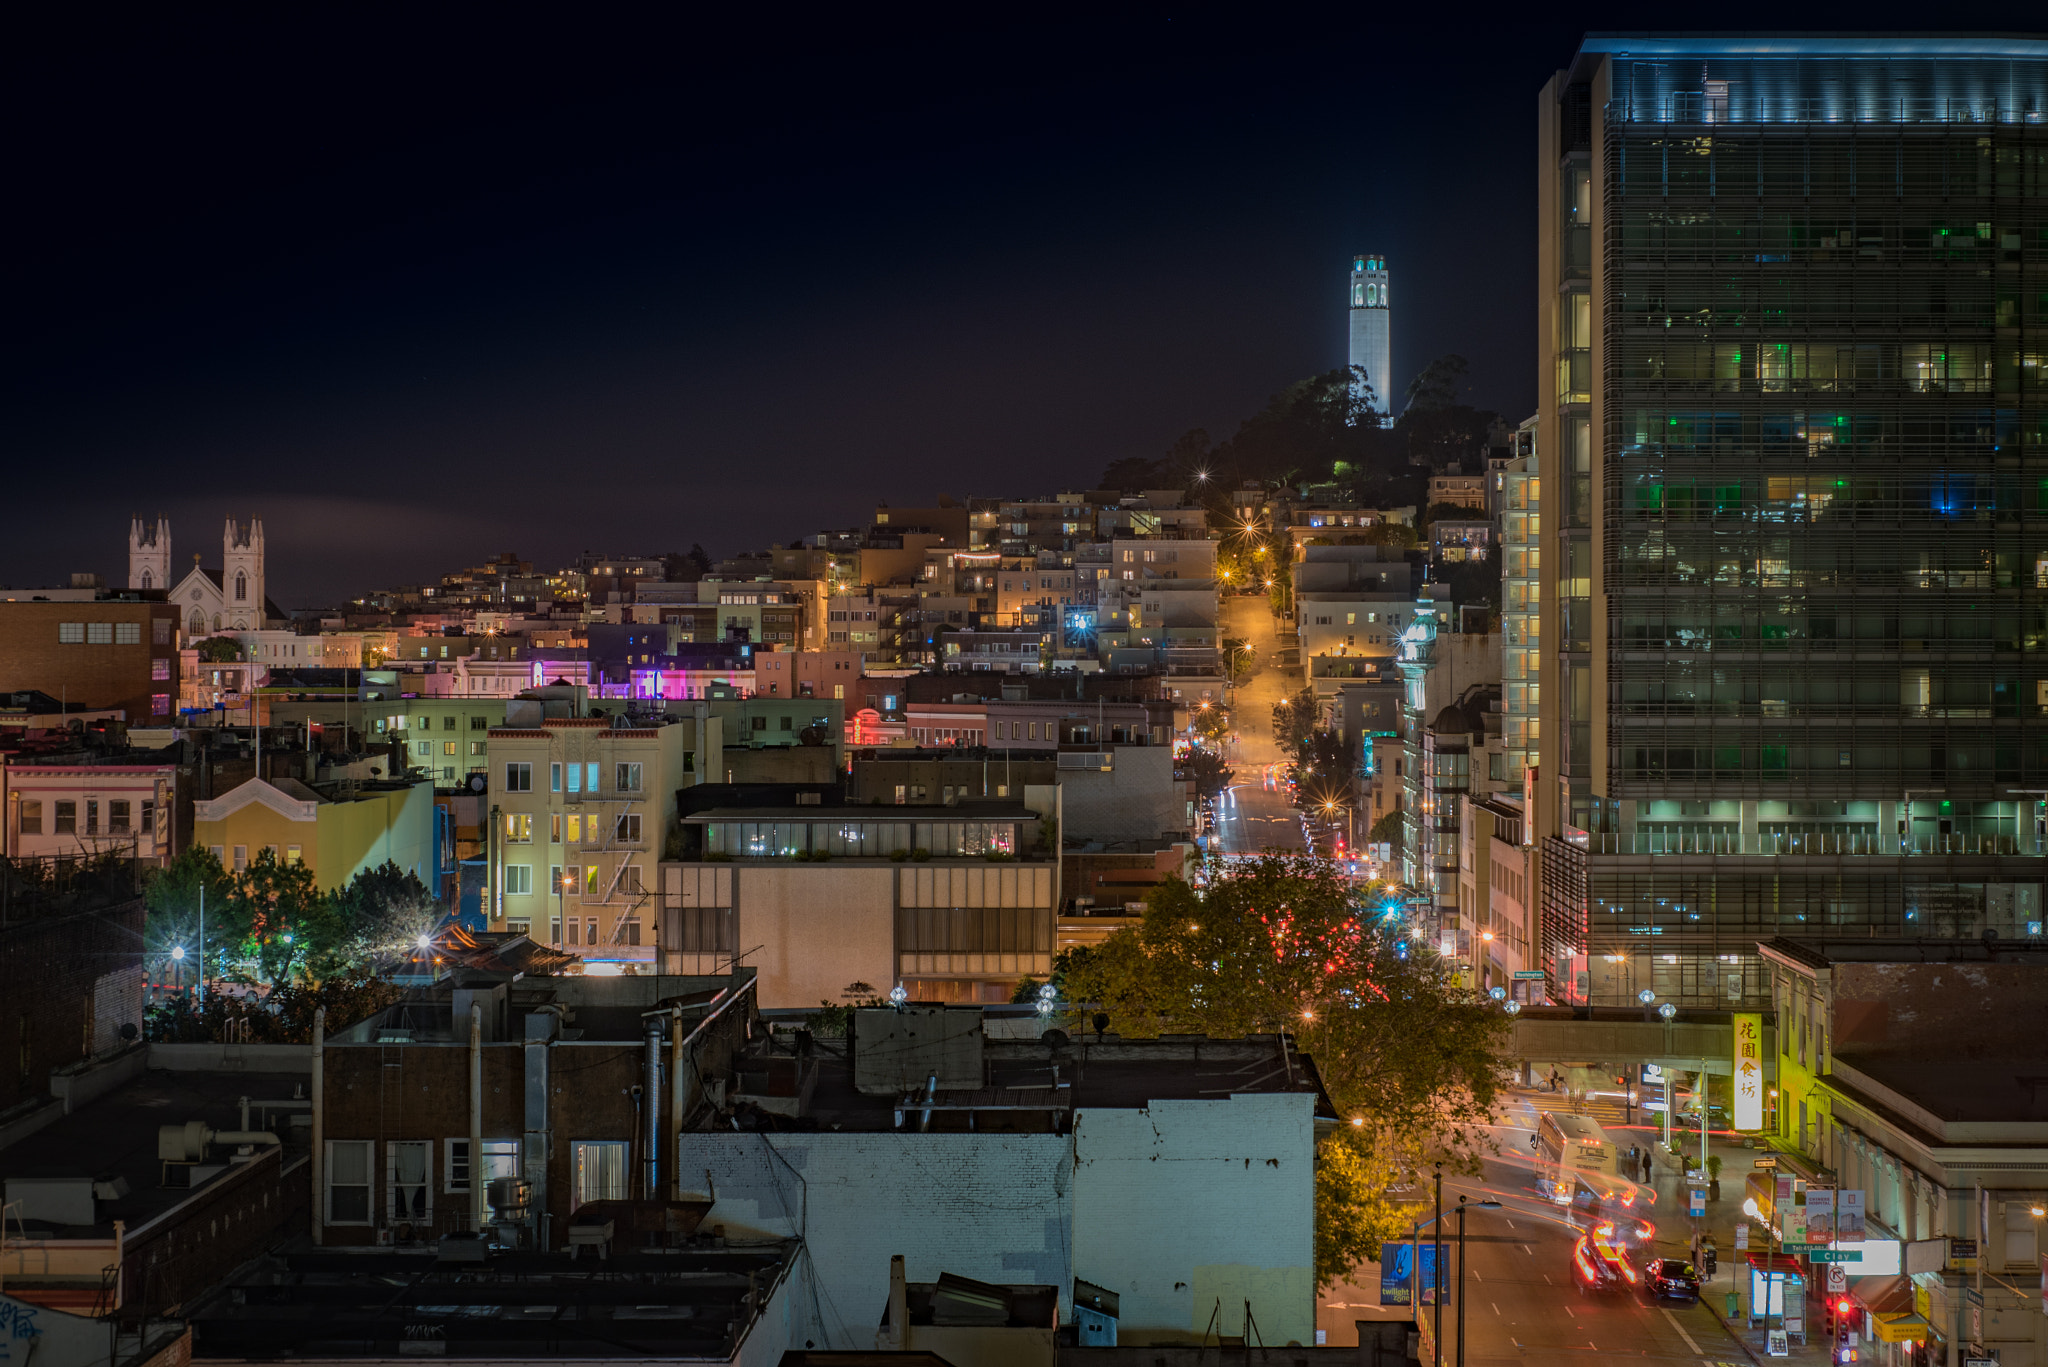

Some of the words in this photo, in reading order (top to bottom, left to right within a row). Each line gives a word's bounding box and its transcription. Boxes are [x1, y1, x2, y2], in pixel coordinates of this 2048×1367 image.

[1740, 1021, 1757, 1099] 花園食坊
[1824, 1252, 1850, 1261] Clay
[1382, 1287, 1409, 1296] twilight
[1393, 1295, 1410, 1303] zone
